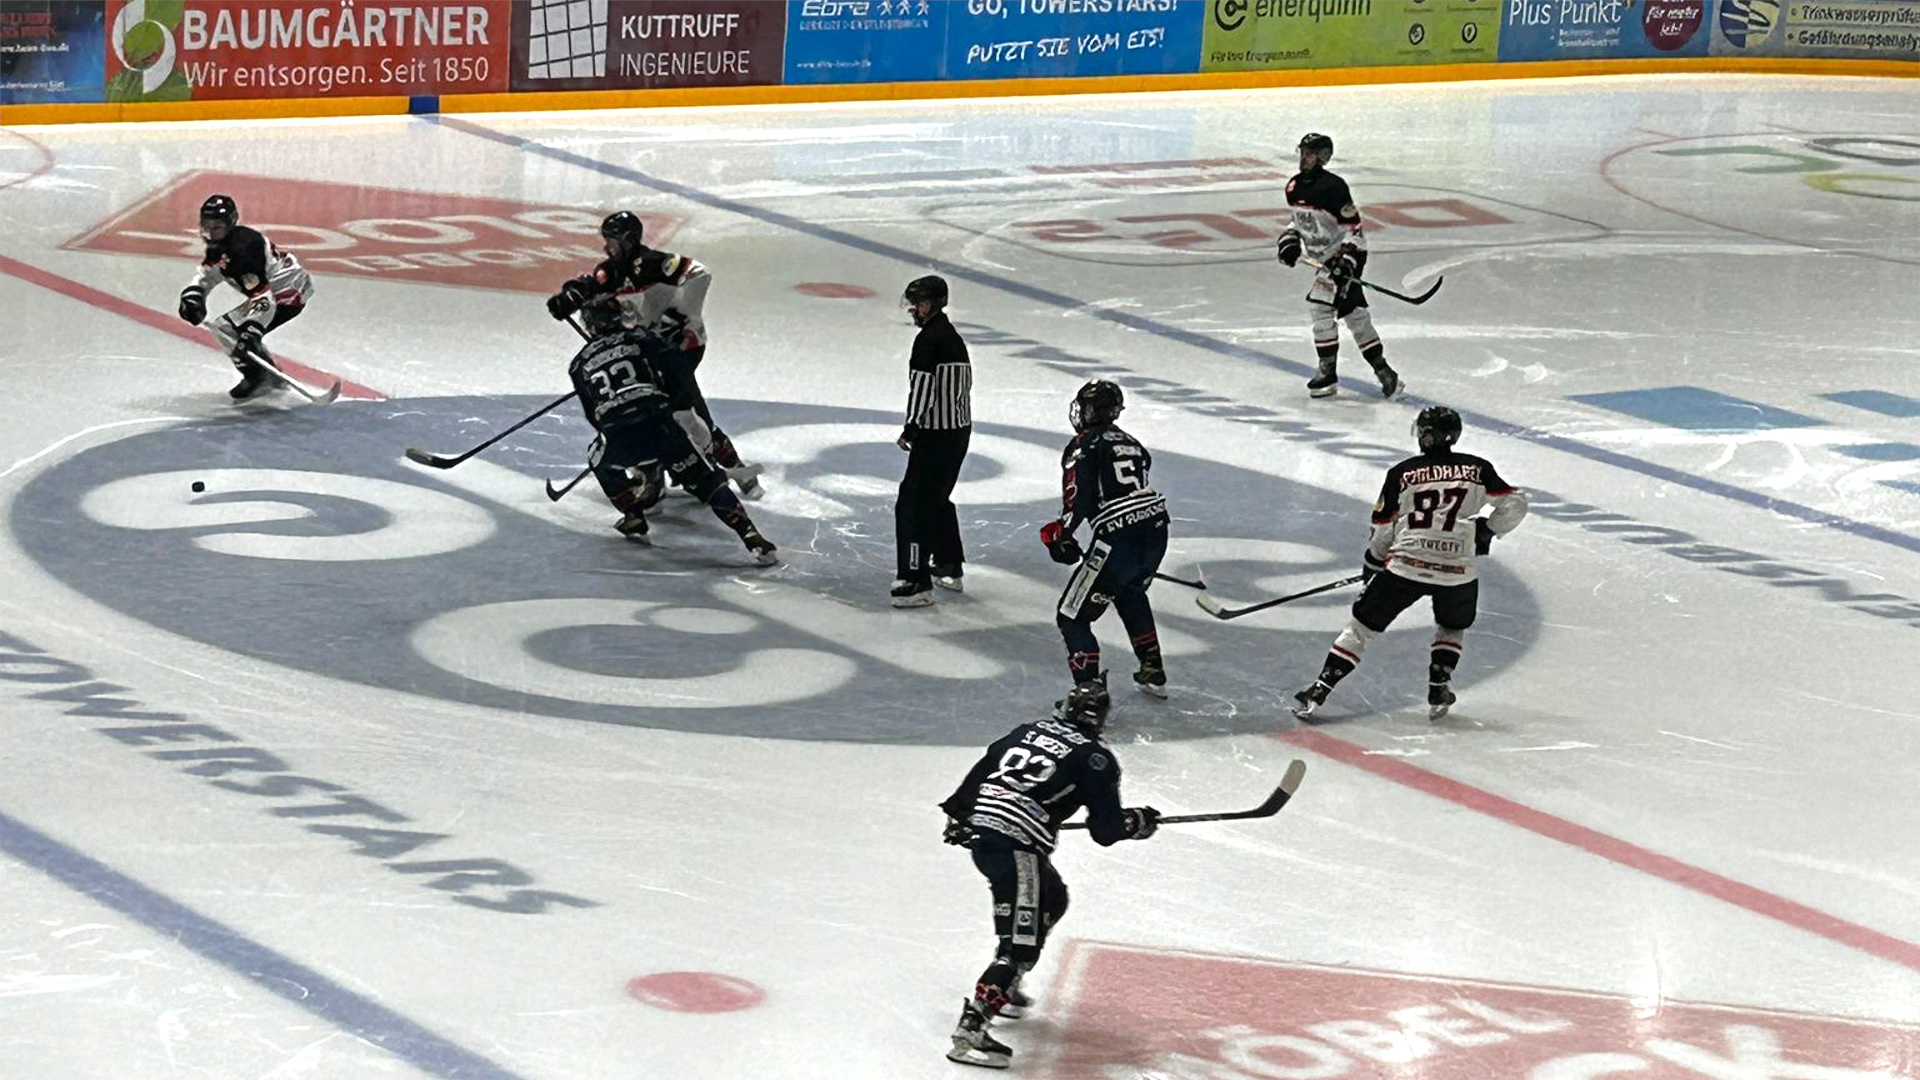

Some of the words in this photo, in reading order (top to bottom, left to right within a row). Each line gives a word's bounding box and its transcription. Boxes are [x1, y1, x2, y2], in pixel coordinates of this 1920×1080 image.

[967, 0, 1008, 19] GO,
[1020, 0, 1178, 15] TOWERSTARS!
[1509, 0, 1552, 26] Plus
[1559, 0, 1623, 25] Punkt
[182, 0, 490, 51] BAUMGÄRTNER
[620, 13, 740, 40] KUTTRUFF
[966, 40, 1034, 65] PUTZT
[1037, 37, 1070, 59] SIE
[1076, 32, 1120, 54] VOM
[1127, 27, 1166, 50] EIS!
[183, 60, 226, 89] Wir
[234, 63, 373, 92] entsorgen.
[379, 57, 427, 84] Seit
[432, 56, 490, 83] 1850
[619, 50, 751, 77] INGENIEURE
